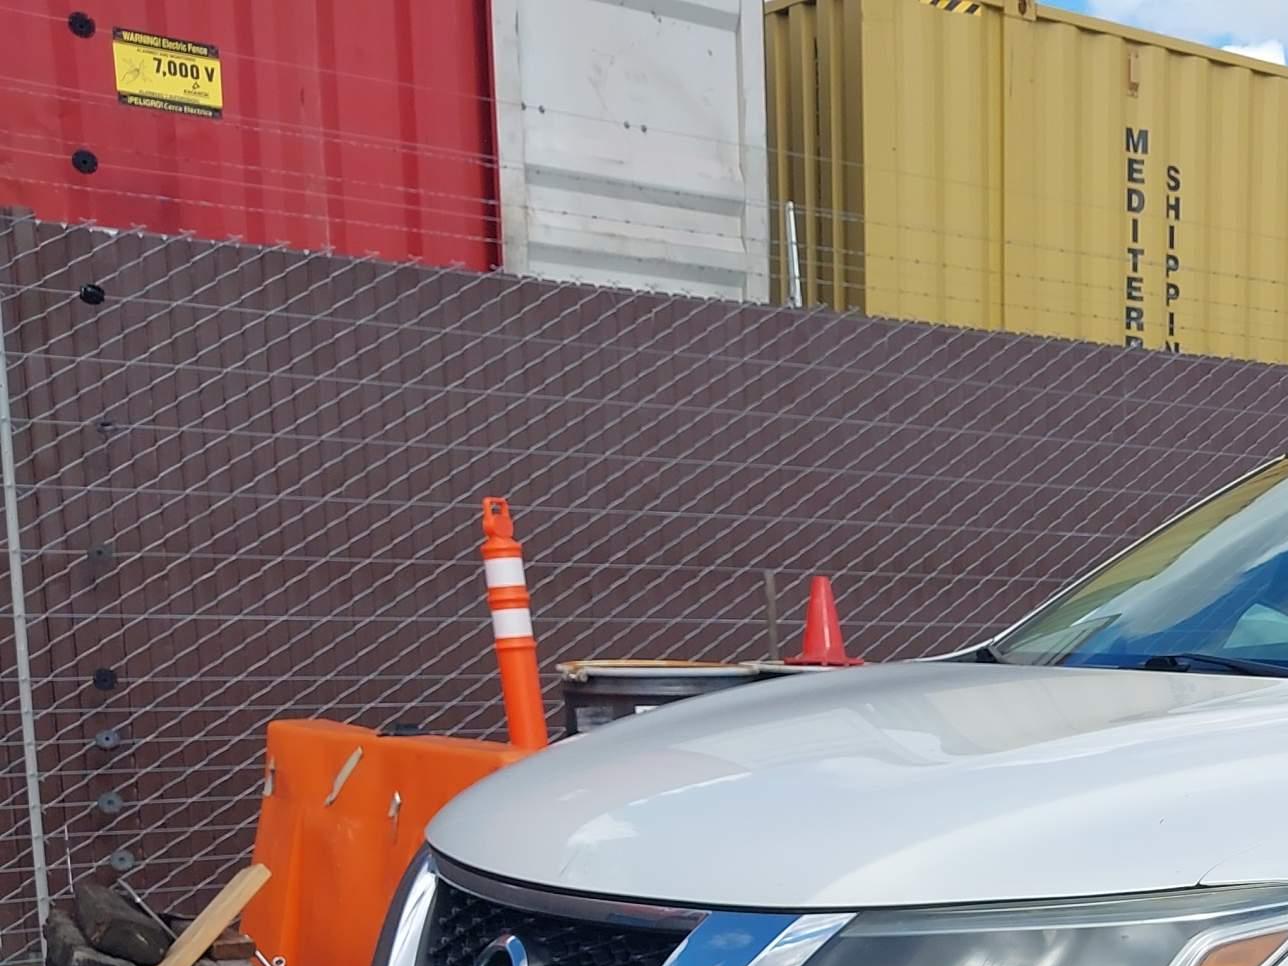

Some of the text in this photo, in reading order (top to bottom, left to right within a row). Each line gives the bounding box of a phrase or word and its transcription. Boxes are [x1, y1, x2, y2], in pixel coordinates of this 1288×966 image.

[122, 31, 161, 48] WARNING!
[162, 38, 187, 52] Electric
[153, 57, 216, 82] 7,000 V
